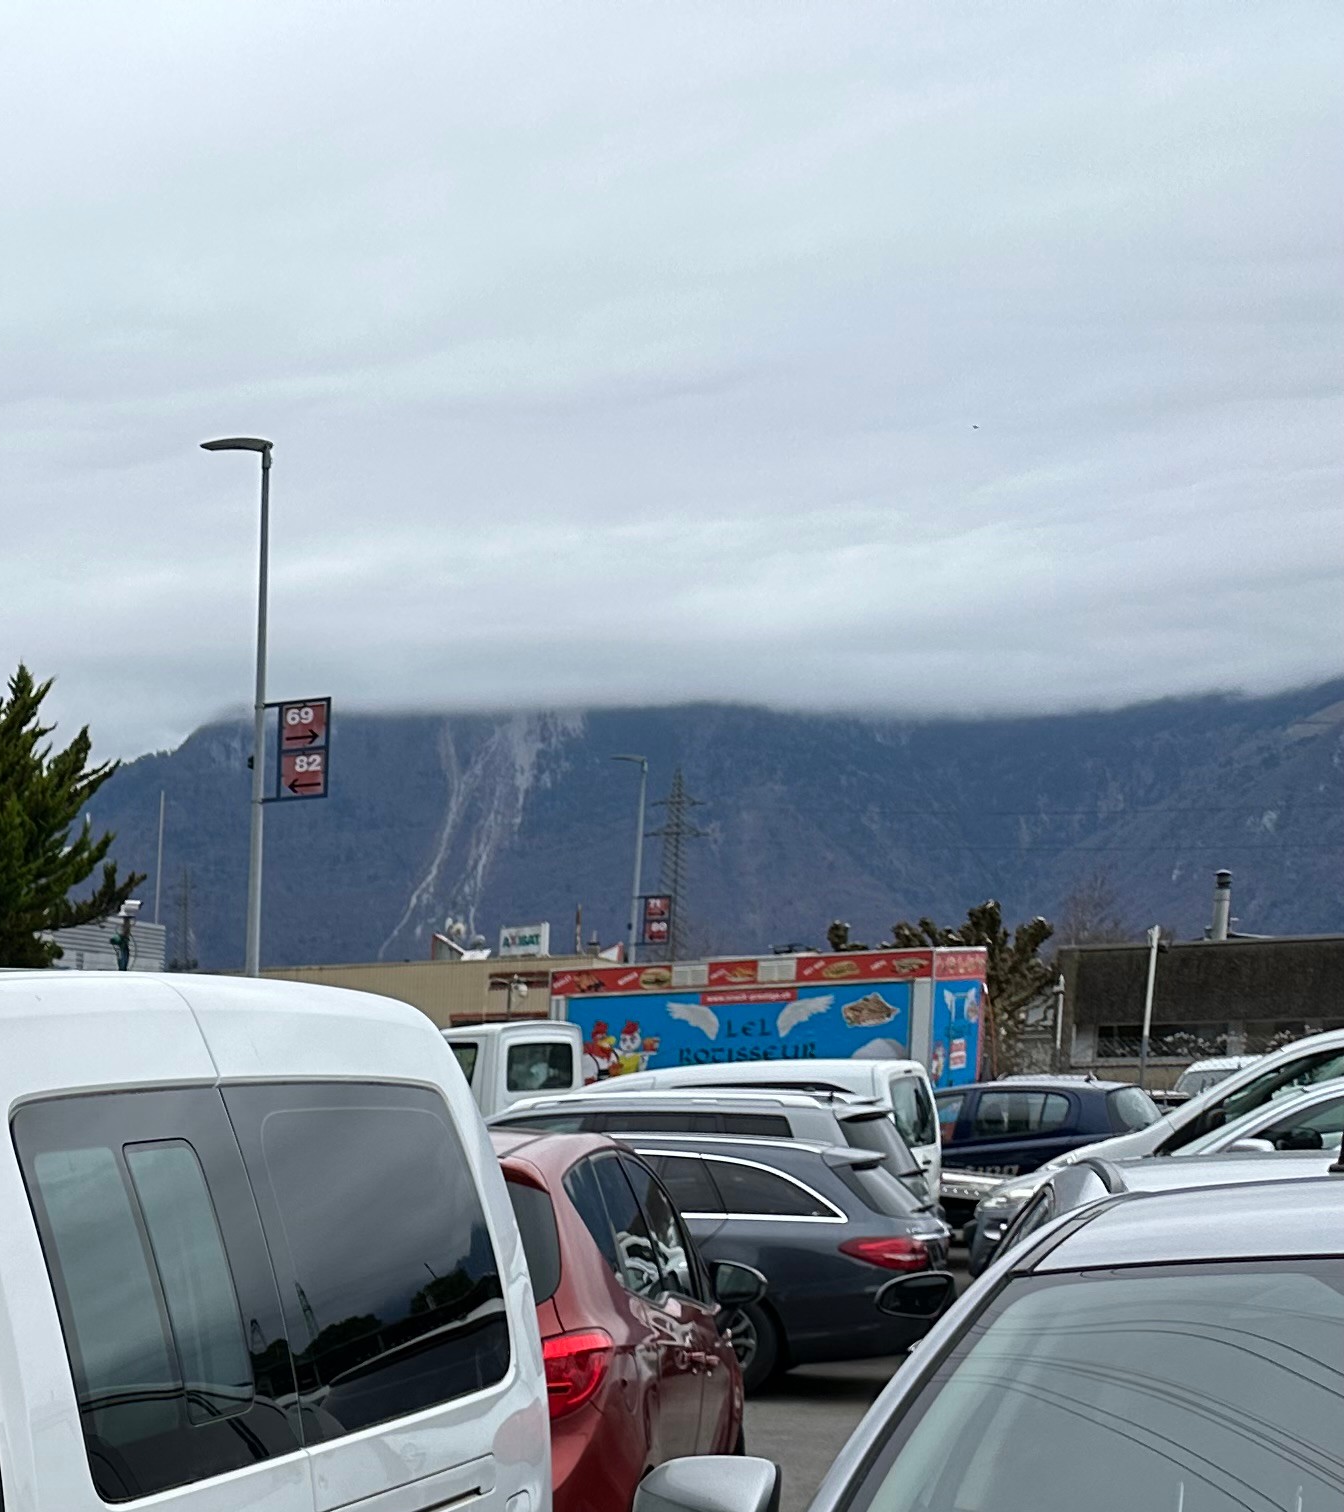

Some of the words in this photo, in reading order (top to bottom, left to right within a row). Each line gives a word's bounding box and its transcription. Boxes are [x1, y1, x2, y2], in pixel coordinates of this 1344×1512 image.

[286, 706, 314, 726] 69
[294, 754, 322, 773] 82
[678, 1041, 816, 1065] ROTISSEUR
